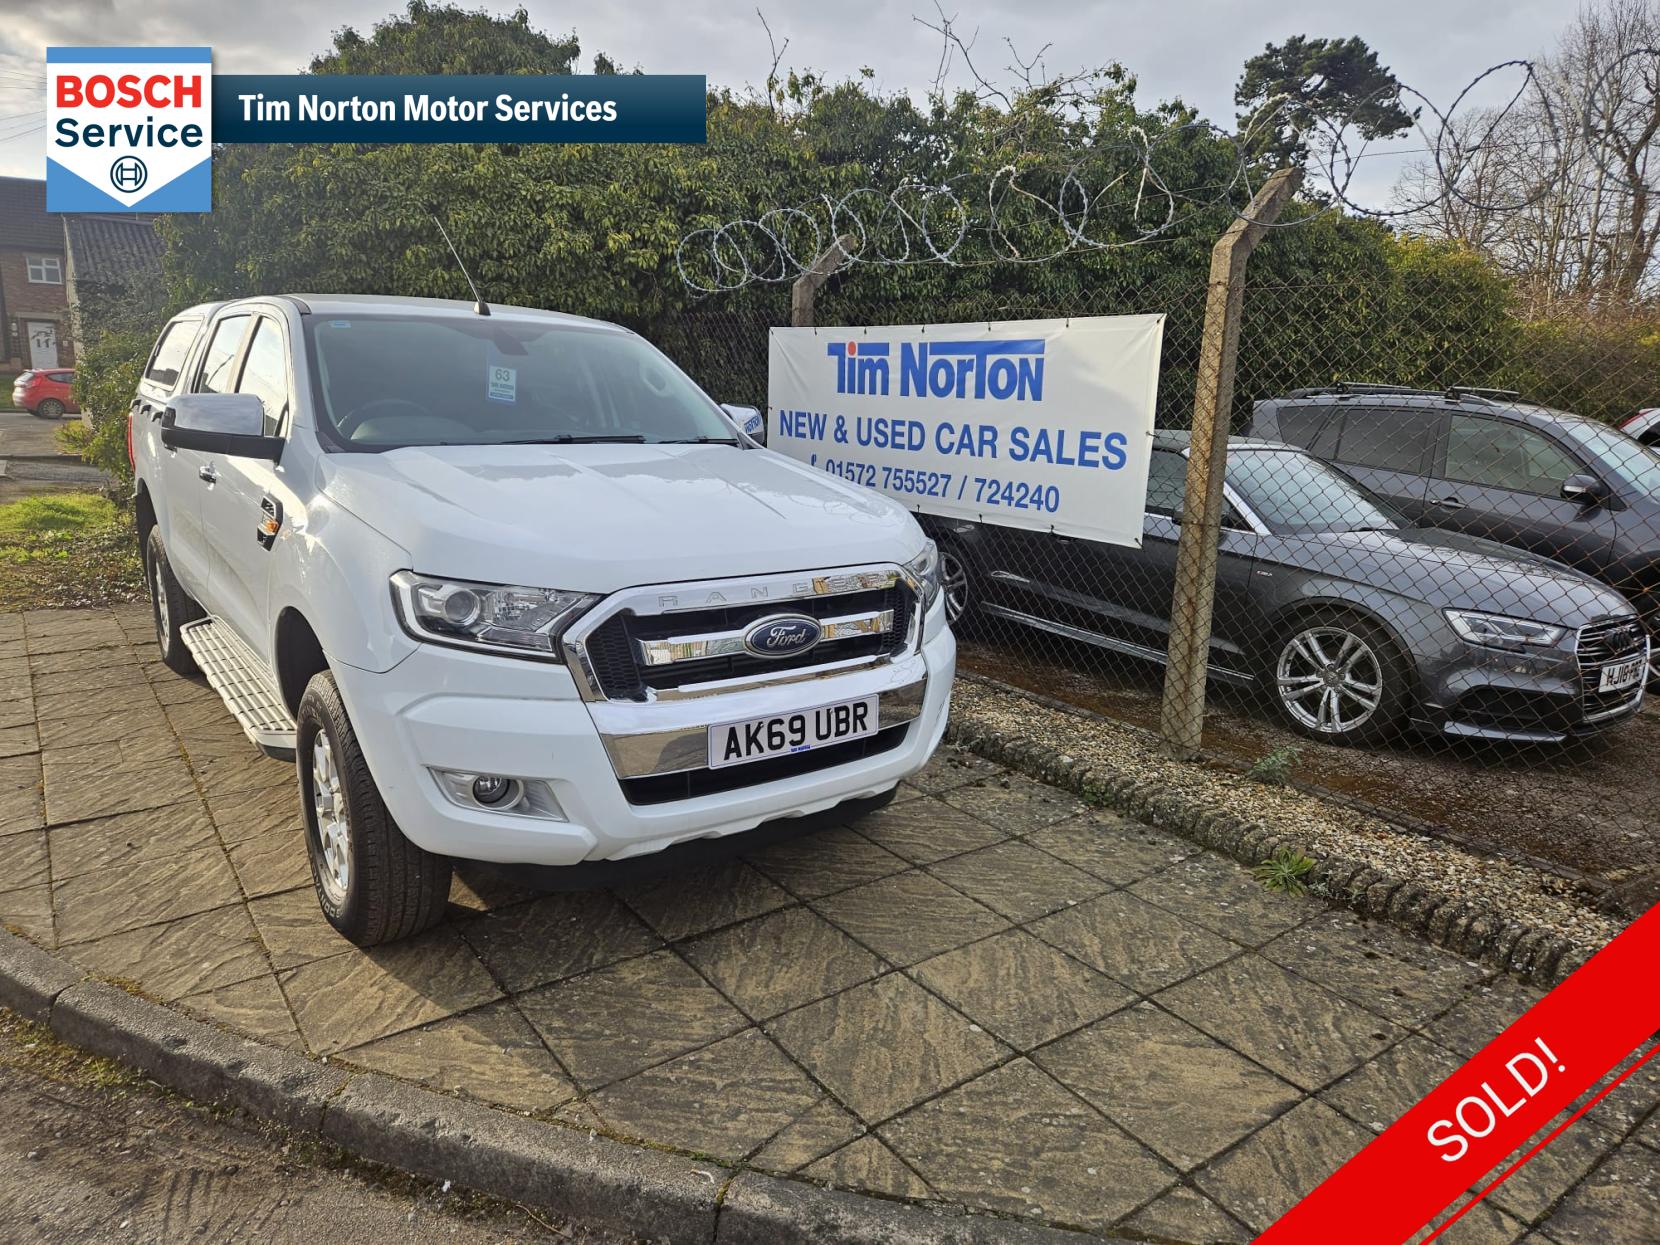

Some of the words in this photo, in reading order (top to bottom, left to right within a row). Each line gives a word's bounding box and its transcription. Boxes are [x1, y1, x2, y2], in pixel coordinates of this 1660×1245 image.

[495, 368, 510, 381] 63
[827, 341, 890, 396] Tim
[779, 410, 828, 441] NEW
[833, 415, 849, 443] &
[856, 416, 926, 451] USED
[935, 422, 998, 458] CAR
[1009, 426, 1128, 470] SALES
[882, 466, 952, 498] 755527
[957, 475, 968, 500] /
[974, 477, 1060, 513] 724240
[766, 625, 807, 647] Ford
[723, 714, 806, 761] AK69
[815, 701, 869, 741] UBR
